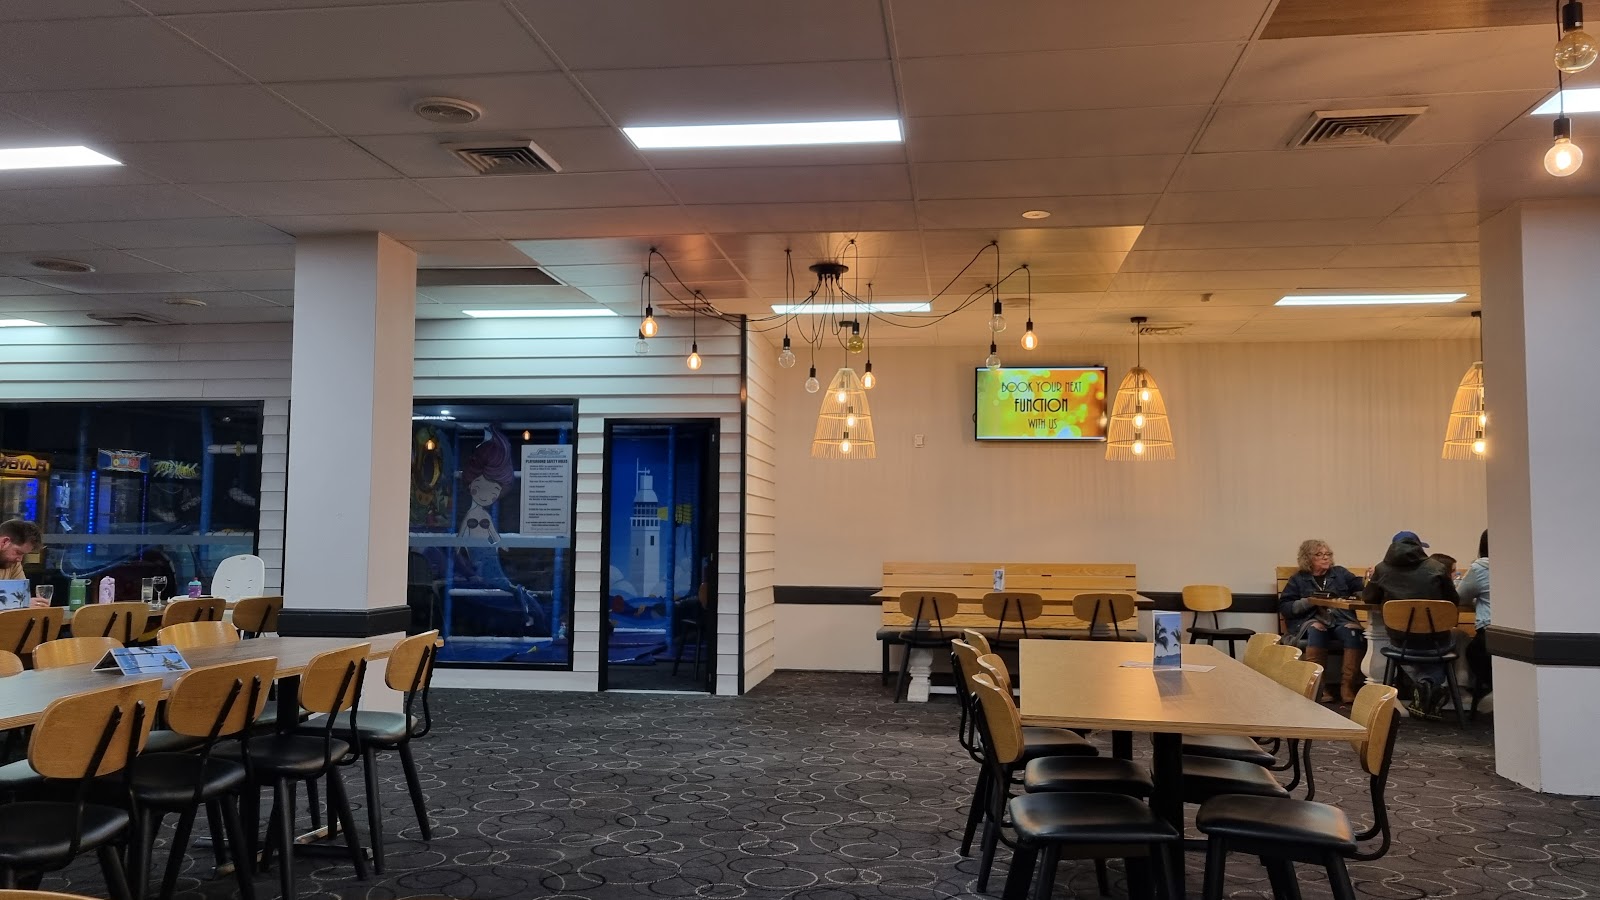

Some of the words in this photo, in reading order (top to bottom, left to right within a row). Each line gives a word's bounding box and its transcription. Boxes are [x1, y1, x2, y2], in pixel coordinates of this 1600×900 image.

[1002, 382, 1032, 392] BOOK
[1036, 382, 1061, 392] YOUR
[1065, 382, 1082, 392] NEXT
[1015, 398, 1068, 412] FUNCTION
[1028, 418, 1046, 429] WITH
[1049, 418, 1058, 429] US
